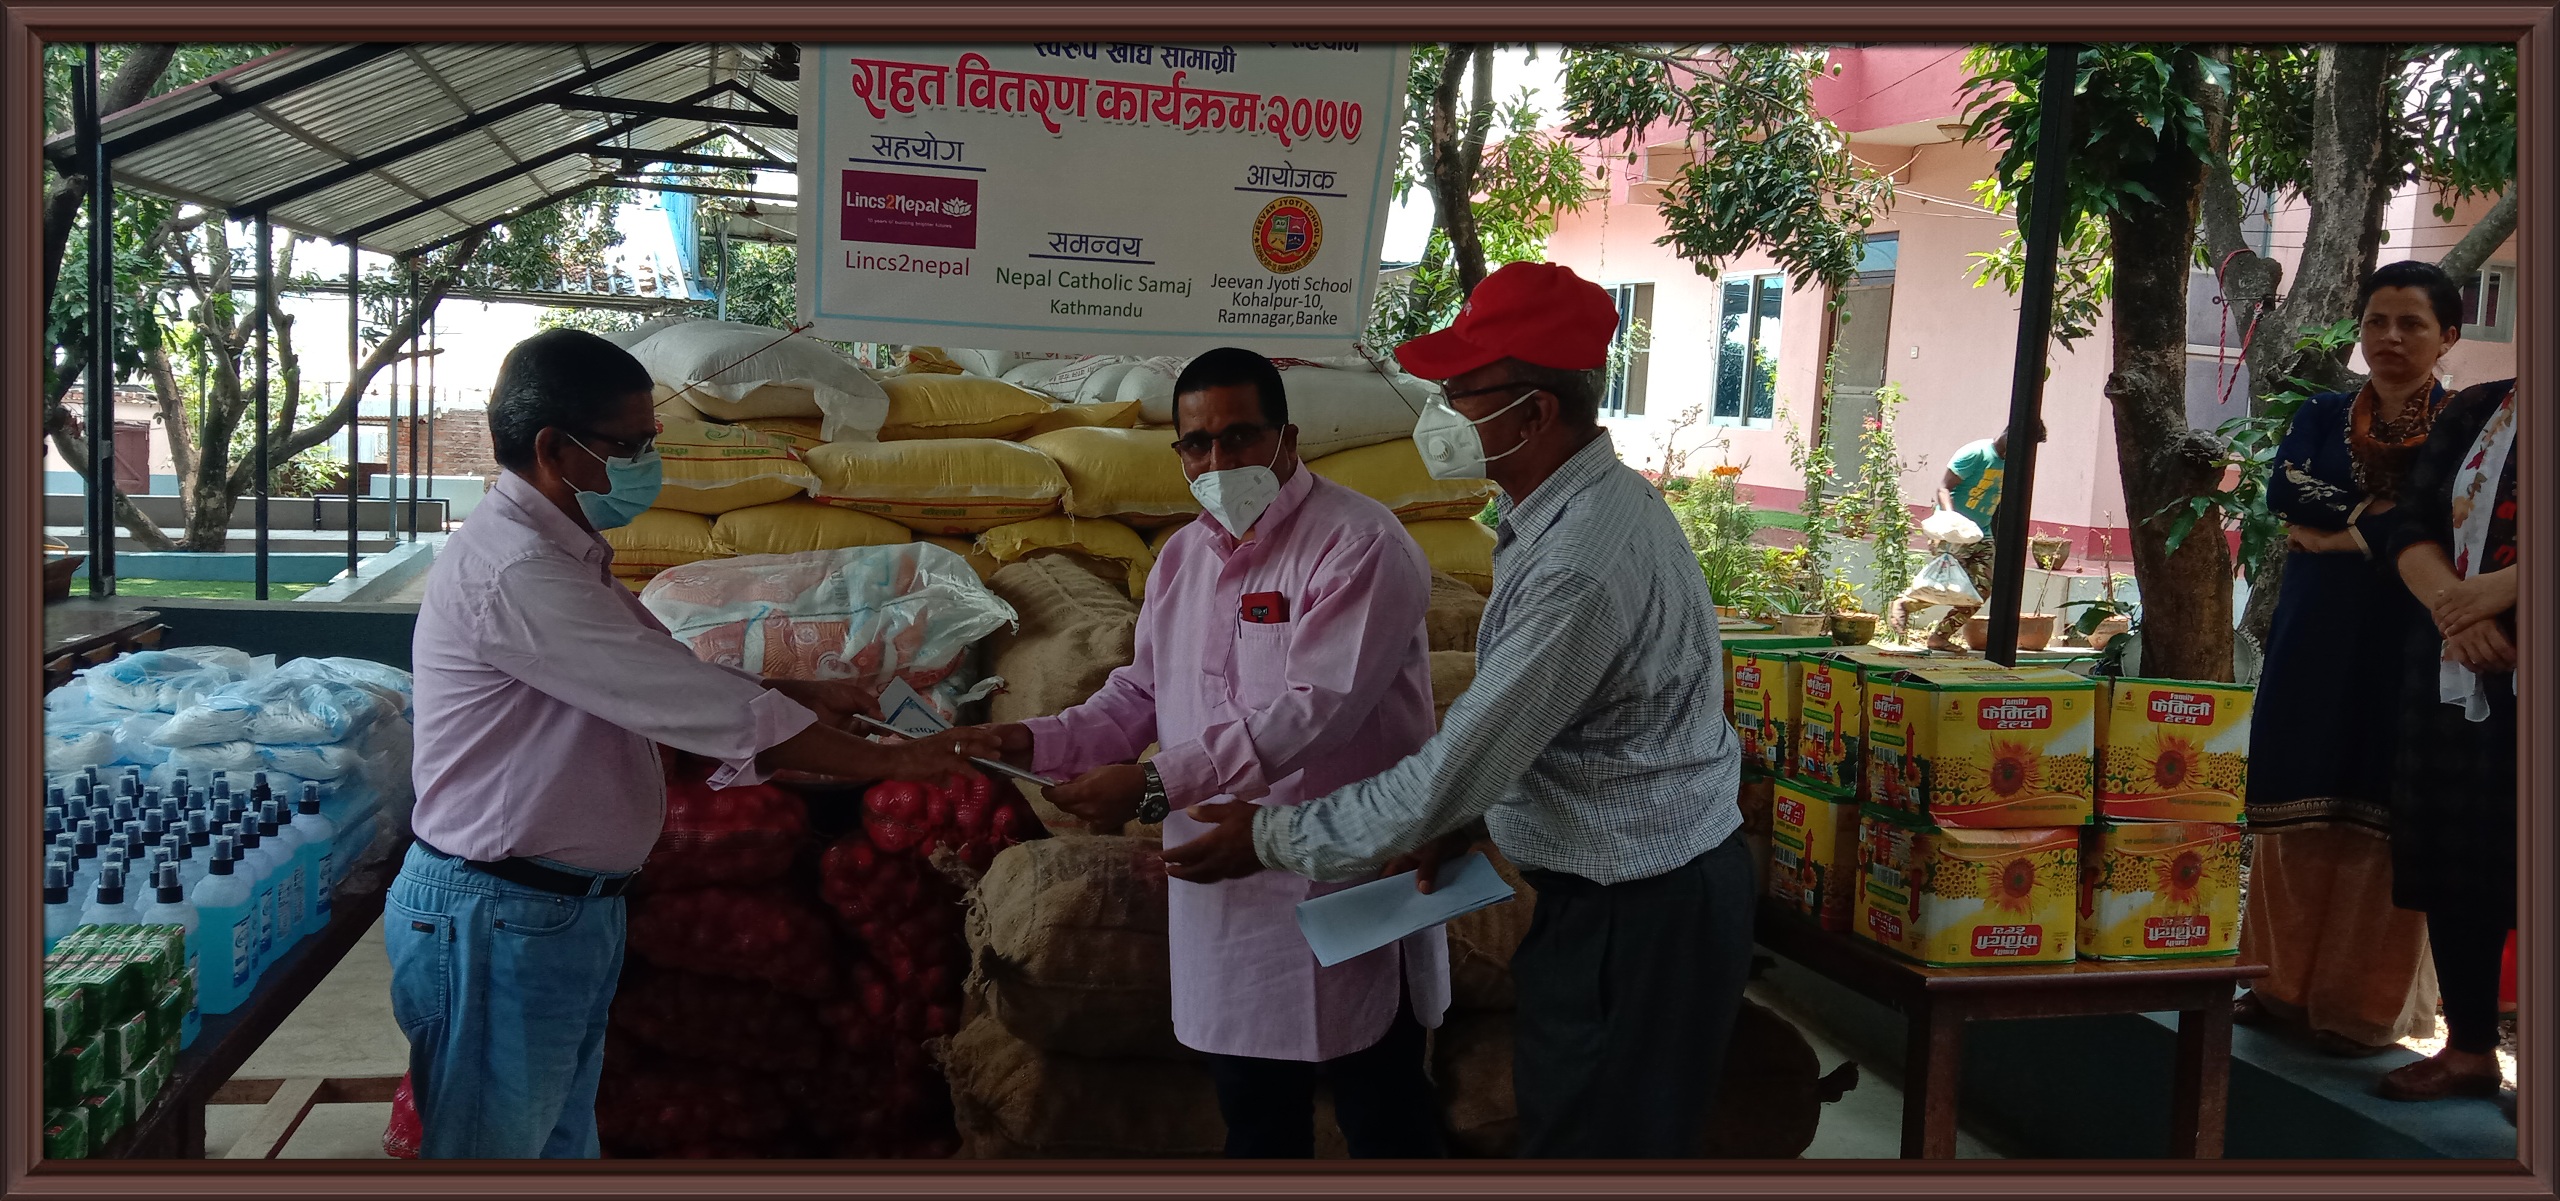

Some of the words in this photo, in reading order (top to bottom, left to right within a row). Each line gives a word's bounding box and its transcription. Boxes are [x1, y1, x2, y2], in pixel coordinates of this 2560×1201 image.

[1160, 45, 1237, 74] सामाग्री
[851, 58, 949, 120] राहत
[956, 53, 1090, 134] वितरण
[870, 131, 965, 162] सहयोग
[1247, 160, 1337, 190] आयोजक
[1254, 204, 1276, 236] JEEVAN
[1278, 199, 1303, 208] JYOTI
[1303, 205, 1320, 240] SCHOOL
[1047, 231, 1143, 257] समन्वय
[845, 250, 970, 278] Lincs2nepal
[996, 267, 1052, 290] Nepal
[1058, 271, 1133, 292] Catholic
[1138, 275, 1192, 297] Samaj
[1210, 273, 1263, 290] Jeevan
[1267, 276, 1301, 294] Jyoti
[1303, 277, 1352, 293] School
[1050, 299, 1143, 318] Kathmandu
[1232, 291, 1324, 310] Kohalpur-10,
[1218, 309, 1338, 328] Ramnagar,Banke
[2002, 698, 2029, 706] Family
